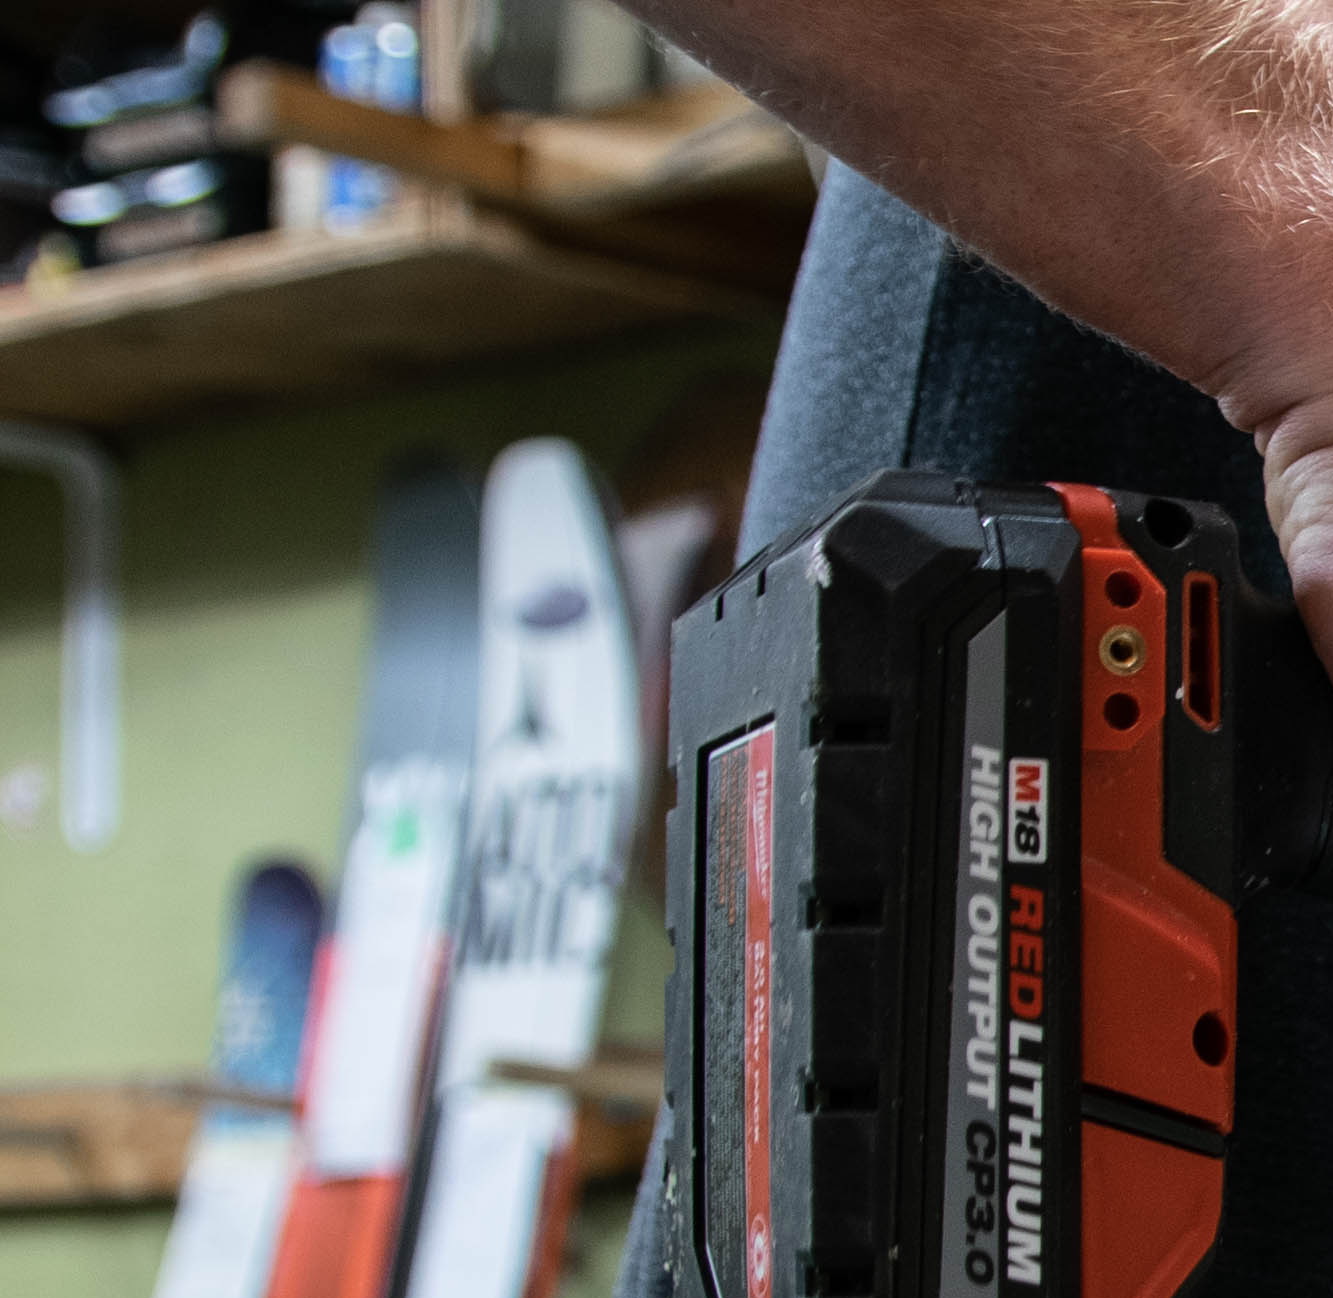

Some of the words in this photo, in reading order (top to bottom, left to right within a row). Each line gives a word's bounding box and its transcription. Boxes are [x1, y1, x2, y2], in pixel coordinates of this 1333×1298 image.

[969, 744, 1001, 882] HIGH
[1015, 764, 1041, 857] M18
[966, 893, 1000, 1112] OUTPUT
[1007, 883, 1044, 1286] REDLITHIUM
[965, 1119, 997, 1287] CP3.0
